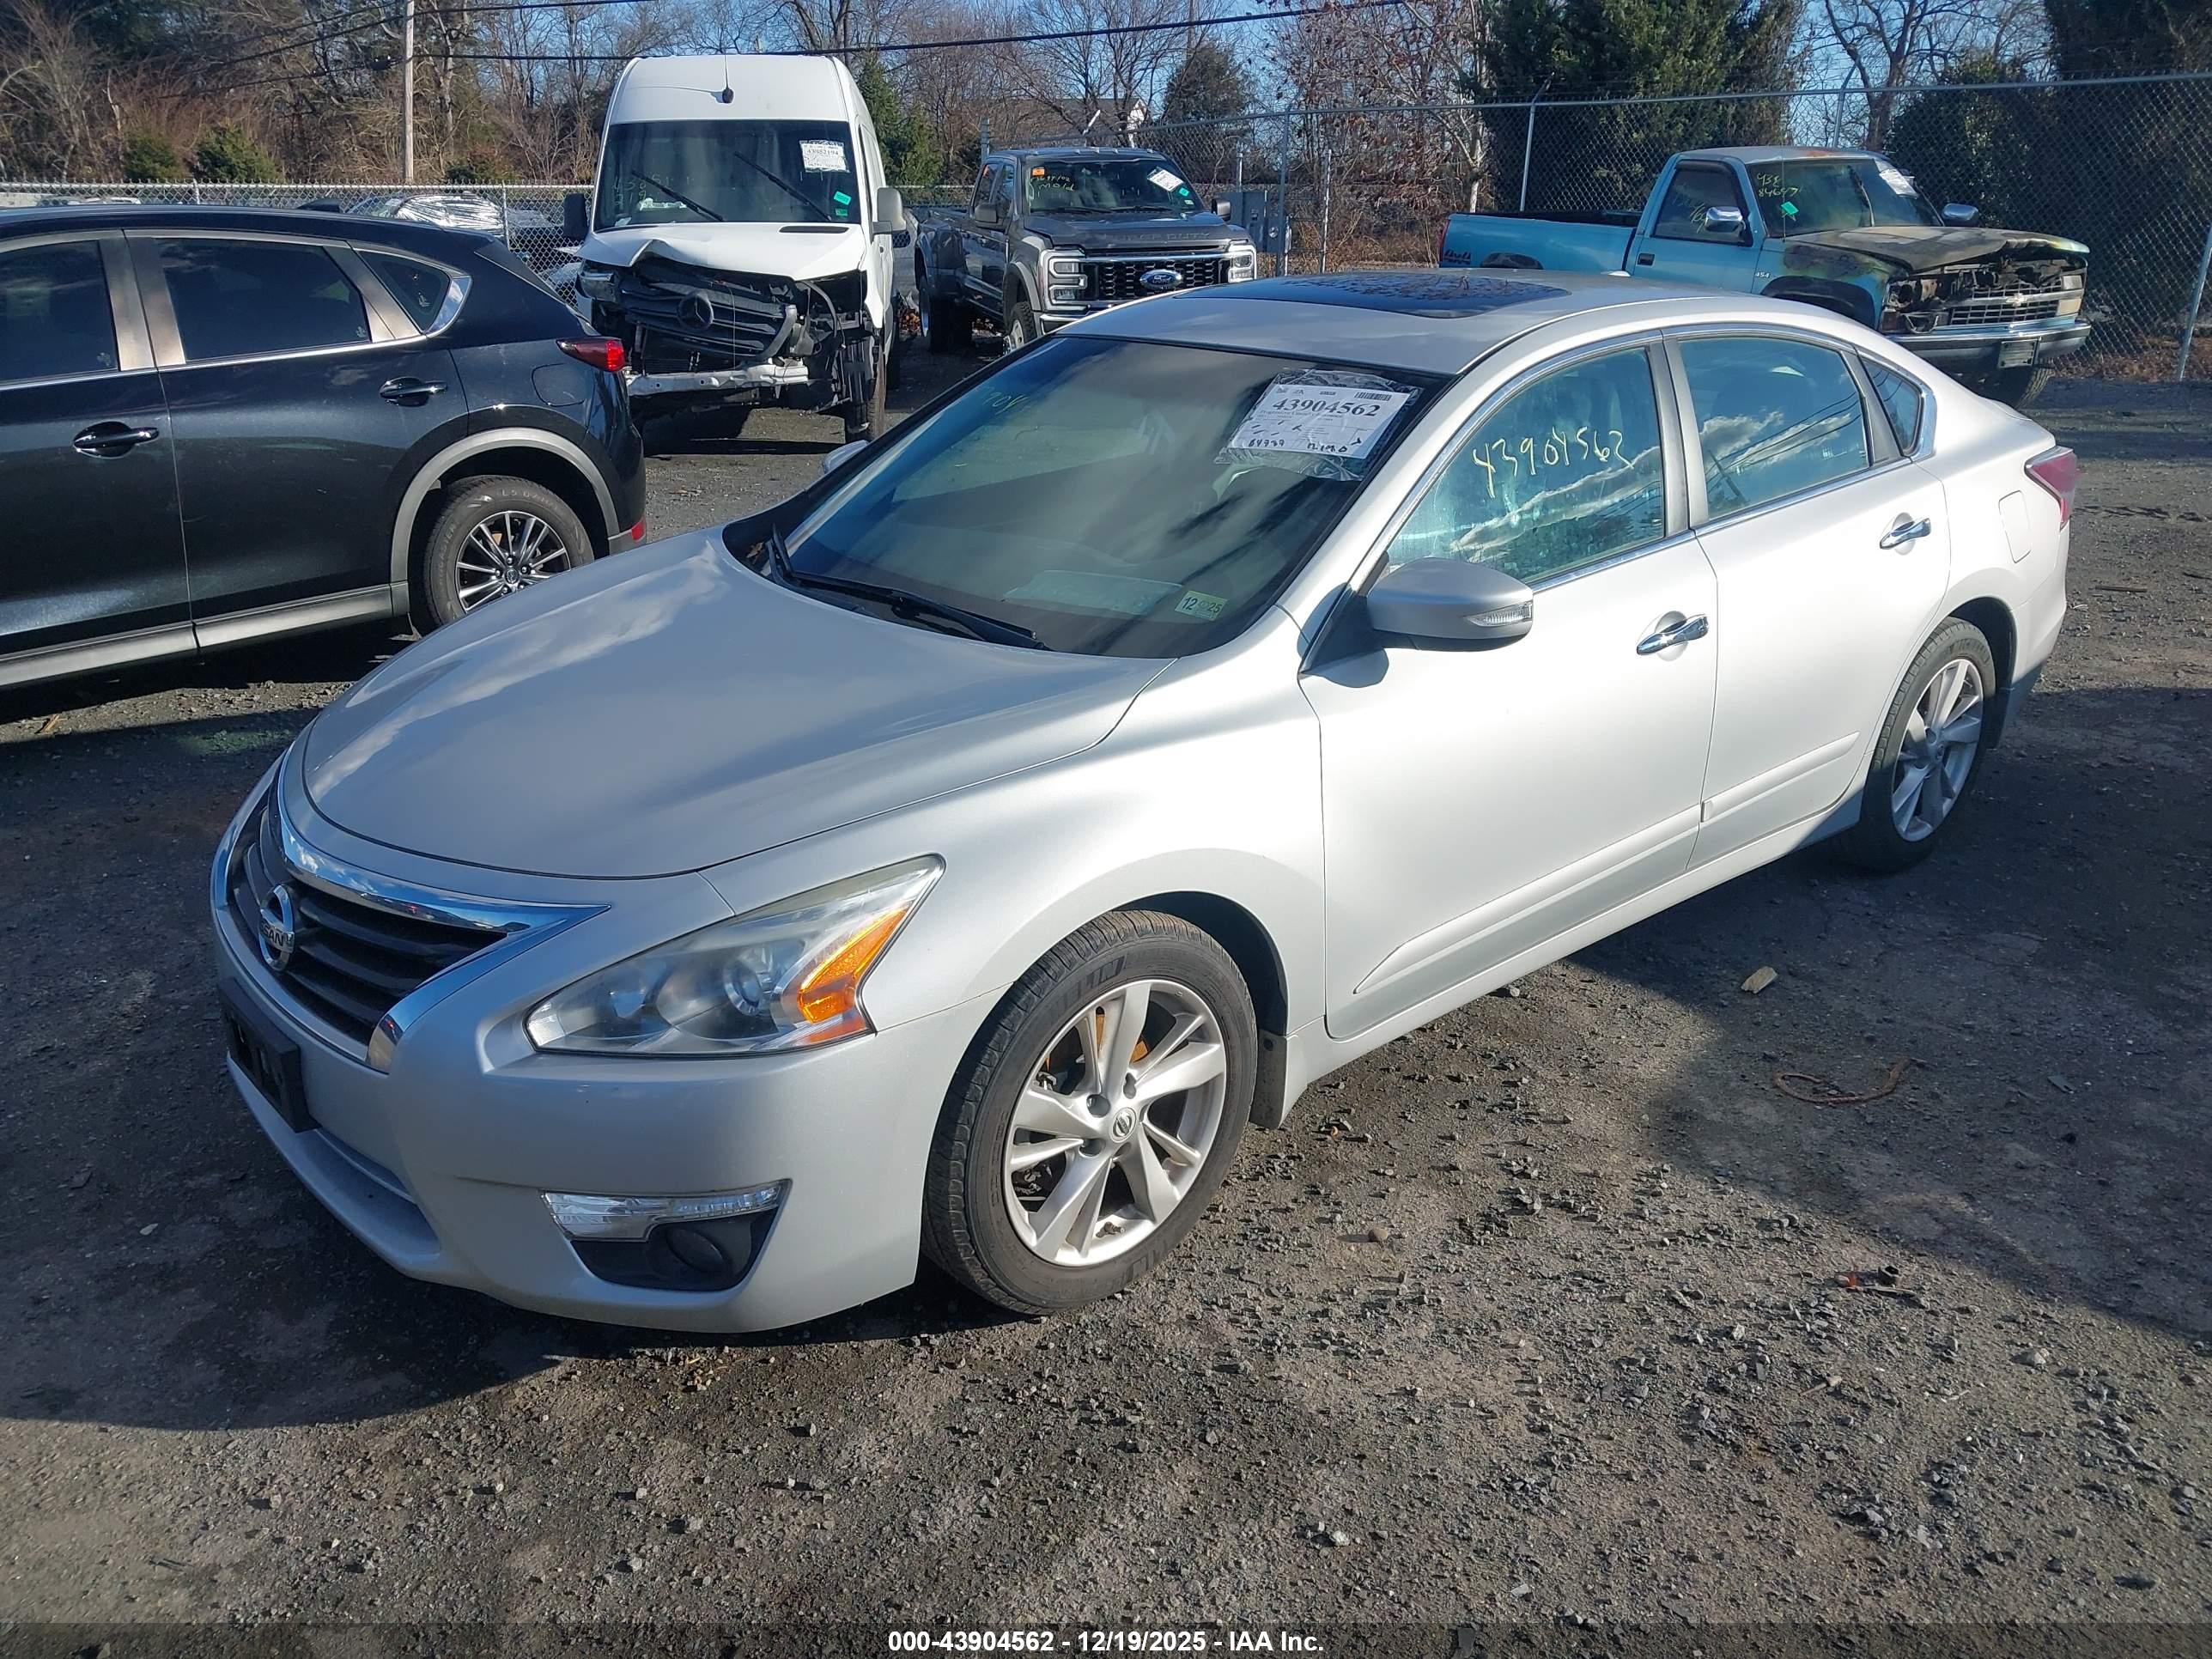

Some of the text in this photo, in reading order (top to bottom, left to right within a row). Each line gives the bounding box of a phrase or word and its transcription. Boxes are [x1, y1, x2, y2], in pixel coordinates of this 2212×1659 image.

[1273, 398, 1381, 417] 43904562
[1472, 426, 1635, 500] 43904562
[1182, 597, 1199, 611] 12
[1207, 602, 1223, 614] 25
